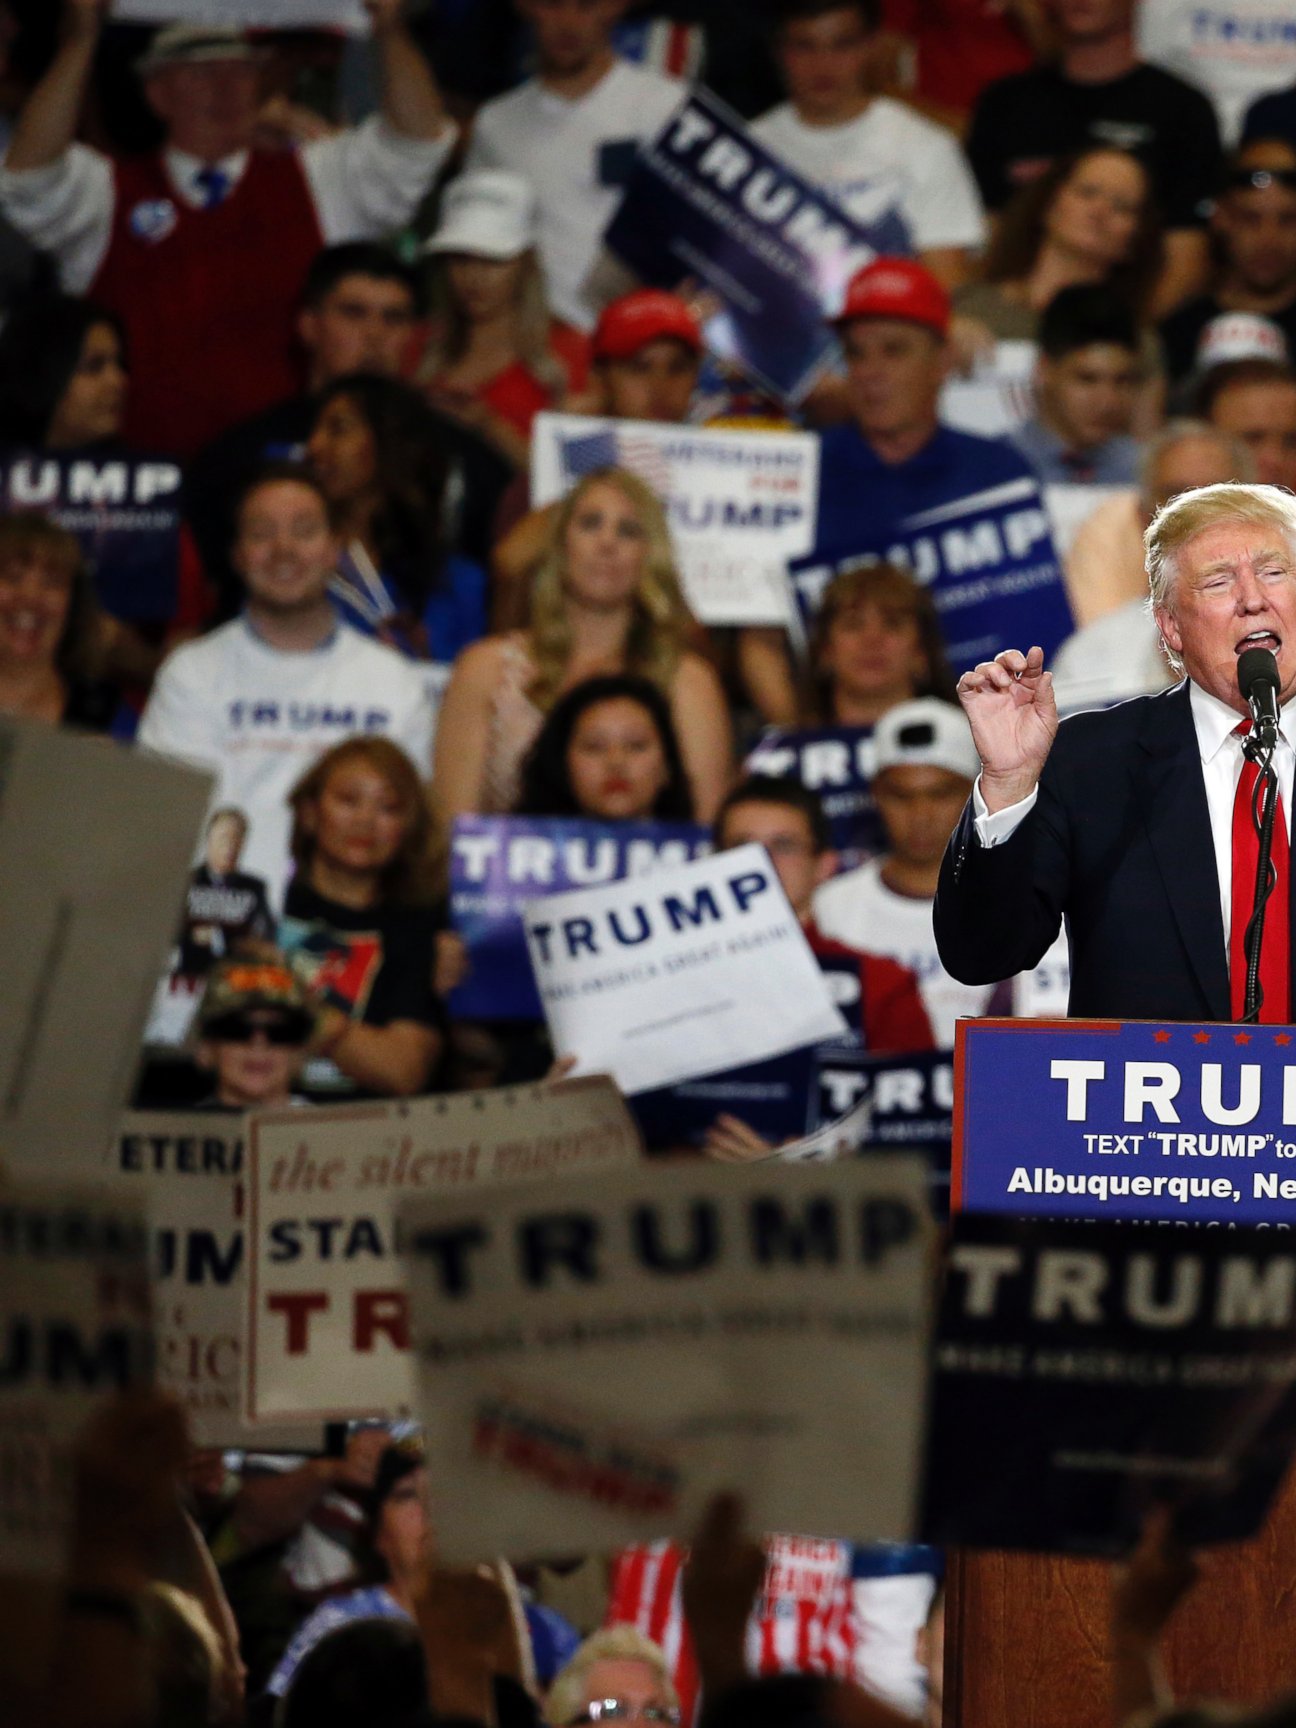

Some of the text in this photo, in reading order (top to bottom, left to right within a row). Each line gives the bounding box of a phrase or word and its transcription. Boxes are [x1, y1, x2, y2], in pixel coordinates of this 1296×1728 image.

[0, 457, 184, 506] UMP
[662, 500, 803, 532] UMP
[228, 698, 390, 733] TRUMP
[452, 833, 716, 886] TRUM
[531, 870, 769, 968] TRUMP
[120, 1135, 242, 1174] ETER
[268, 1137, 347, 1193] the
[356, 1133, 483, 1189] silent
[1083, 1134, 1144, 1155] TEXT
[1006, 1166, 1241, 1203] Albuquerque,
[268, 1217, 400, 1262] STA
[414, 1196, 917, 1297] TRUMP
